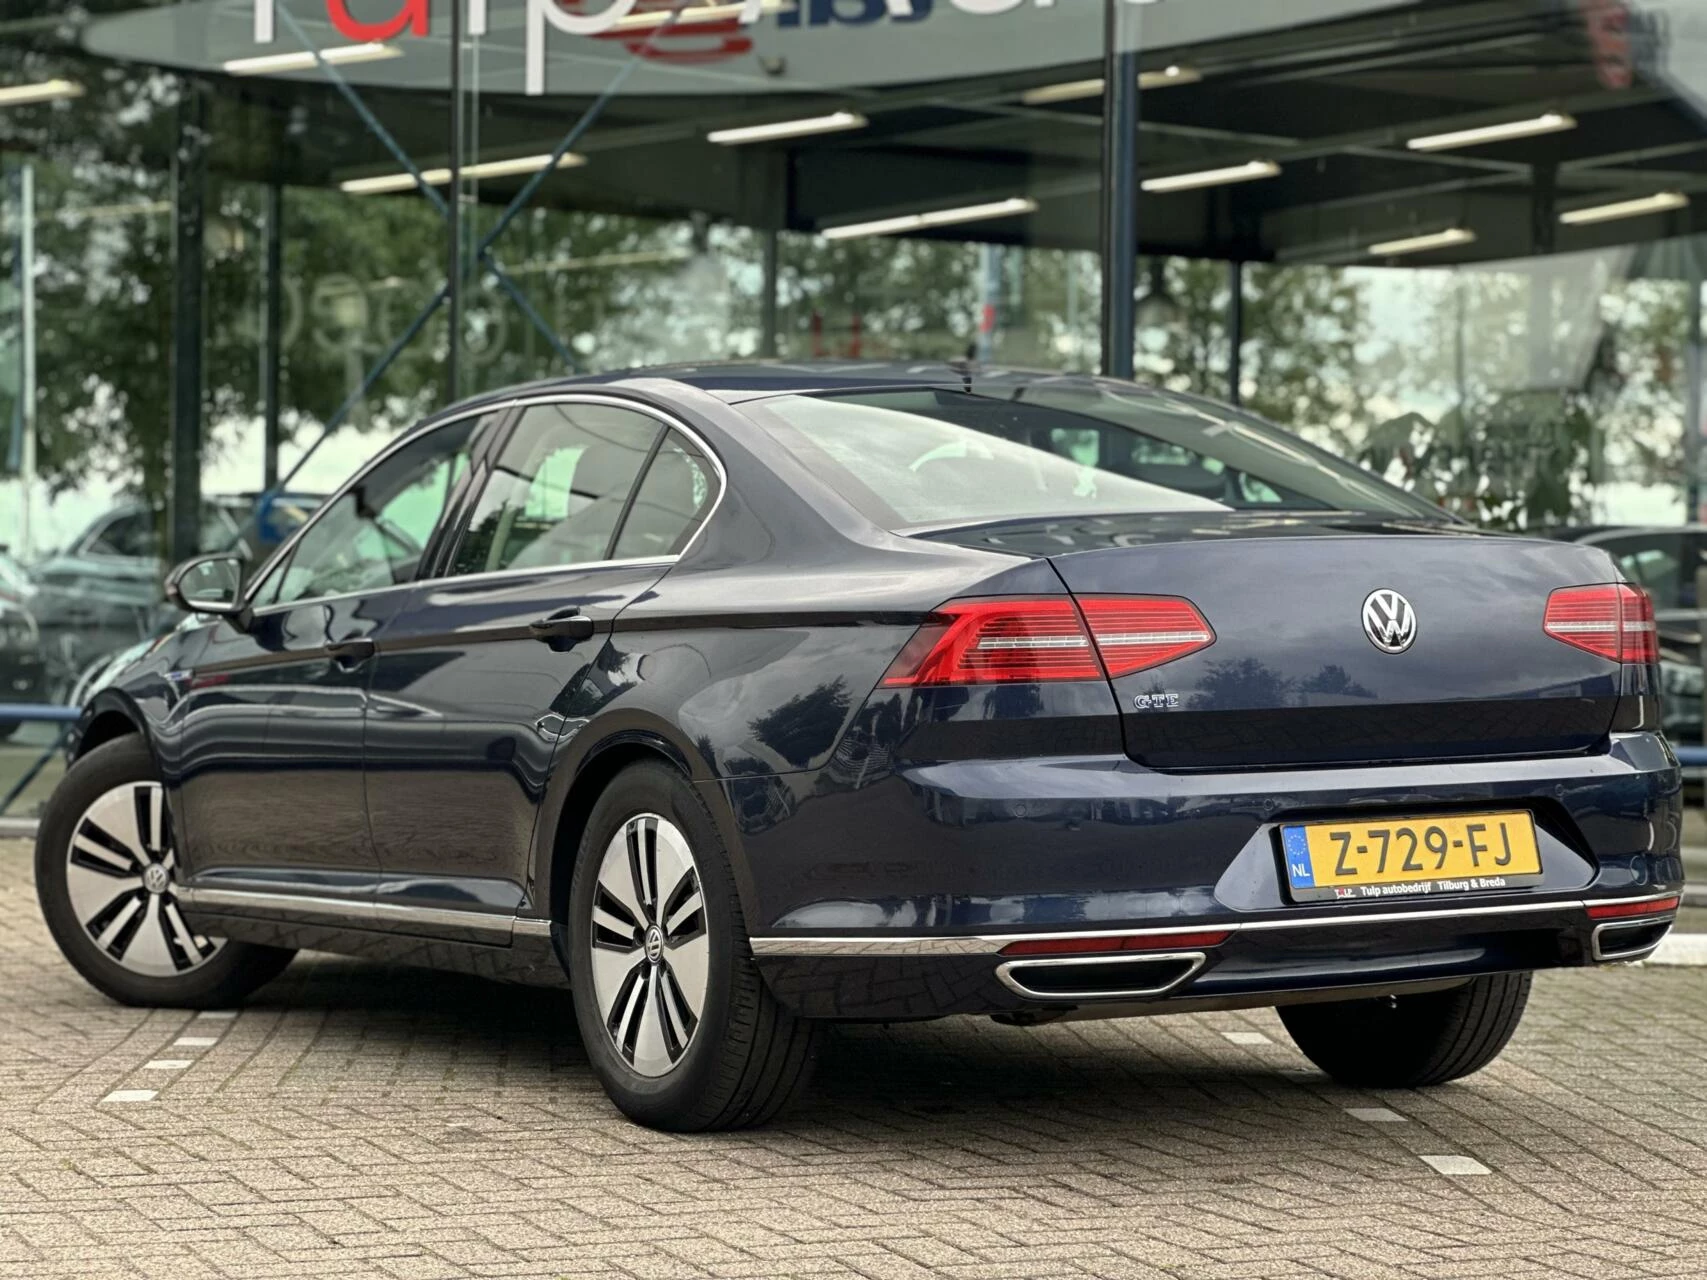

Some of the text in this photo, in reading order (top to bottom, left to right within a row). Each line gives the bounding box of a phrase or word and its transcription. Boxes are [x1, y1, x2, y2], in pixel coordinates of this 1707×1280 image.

[1361, 588, 1417, 653] VW
[1133, 693, 1179, 709] GTE
[1329, 822, 1512, 876] Z-729-FJ
[1292, 863, 1310, 877] NL
[1360, 877, 1506, 897] Tulp autobedrijf Tilburg & Breda
